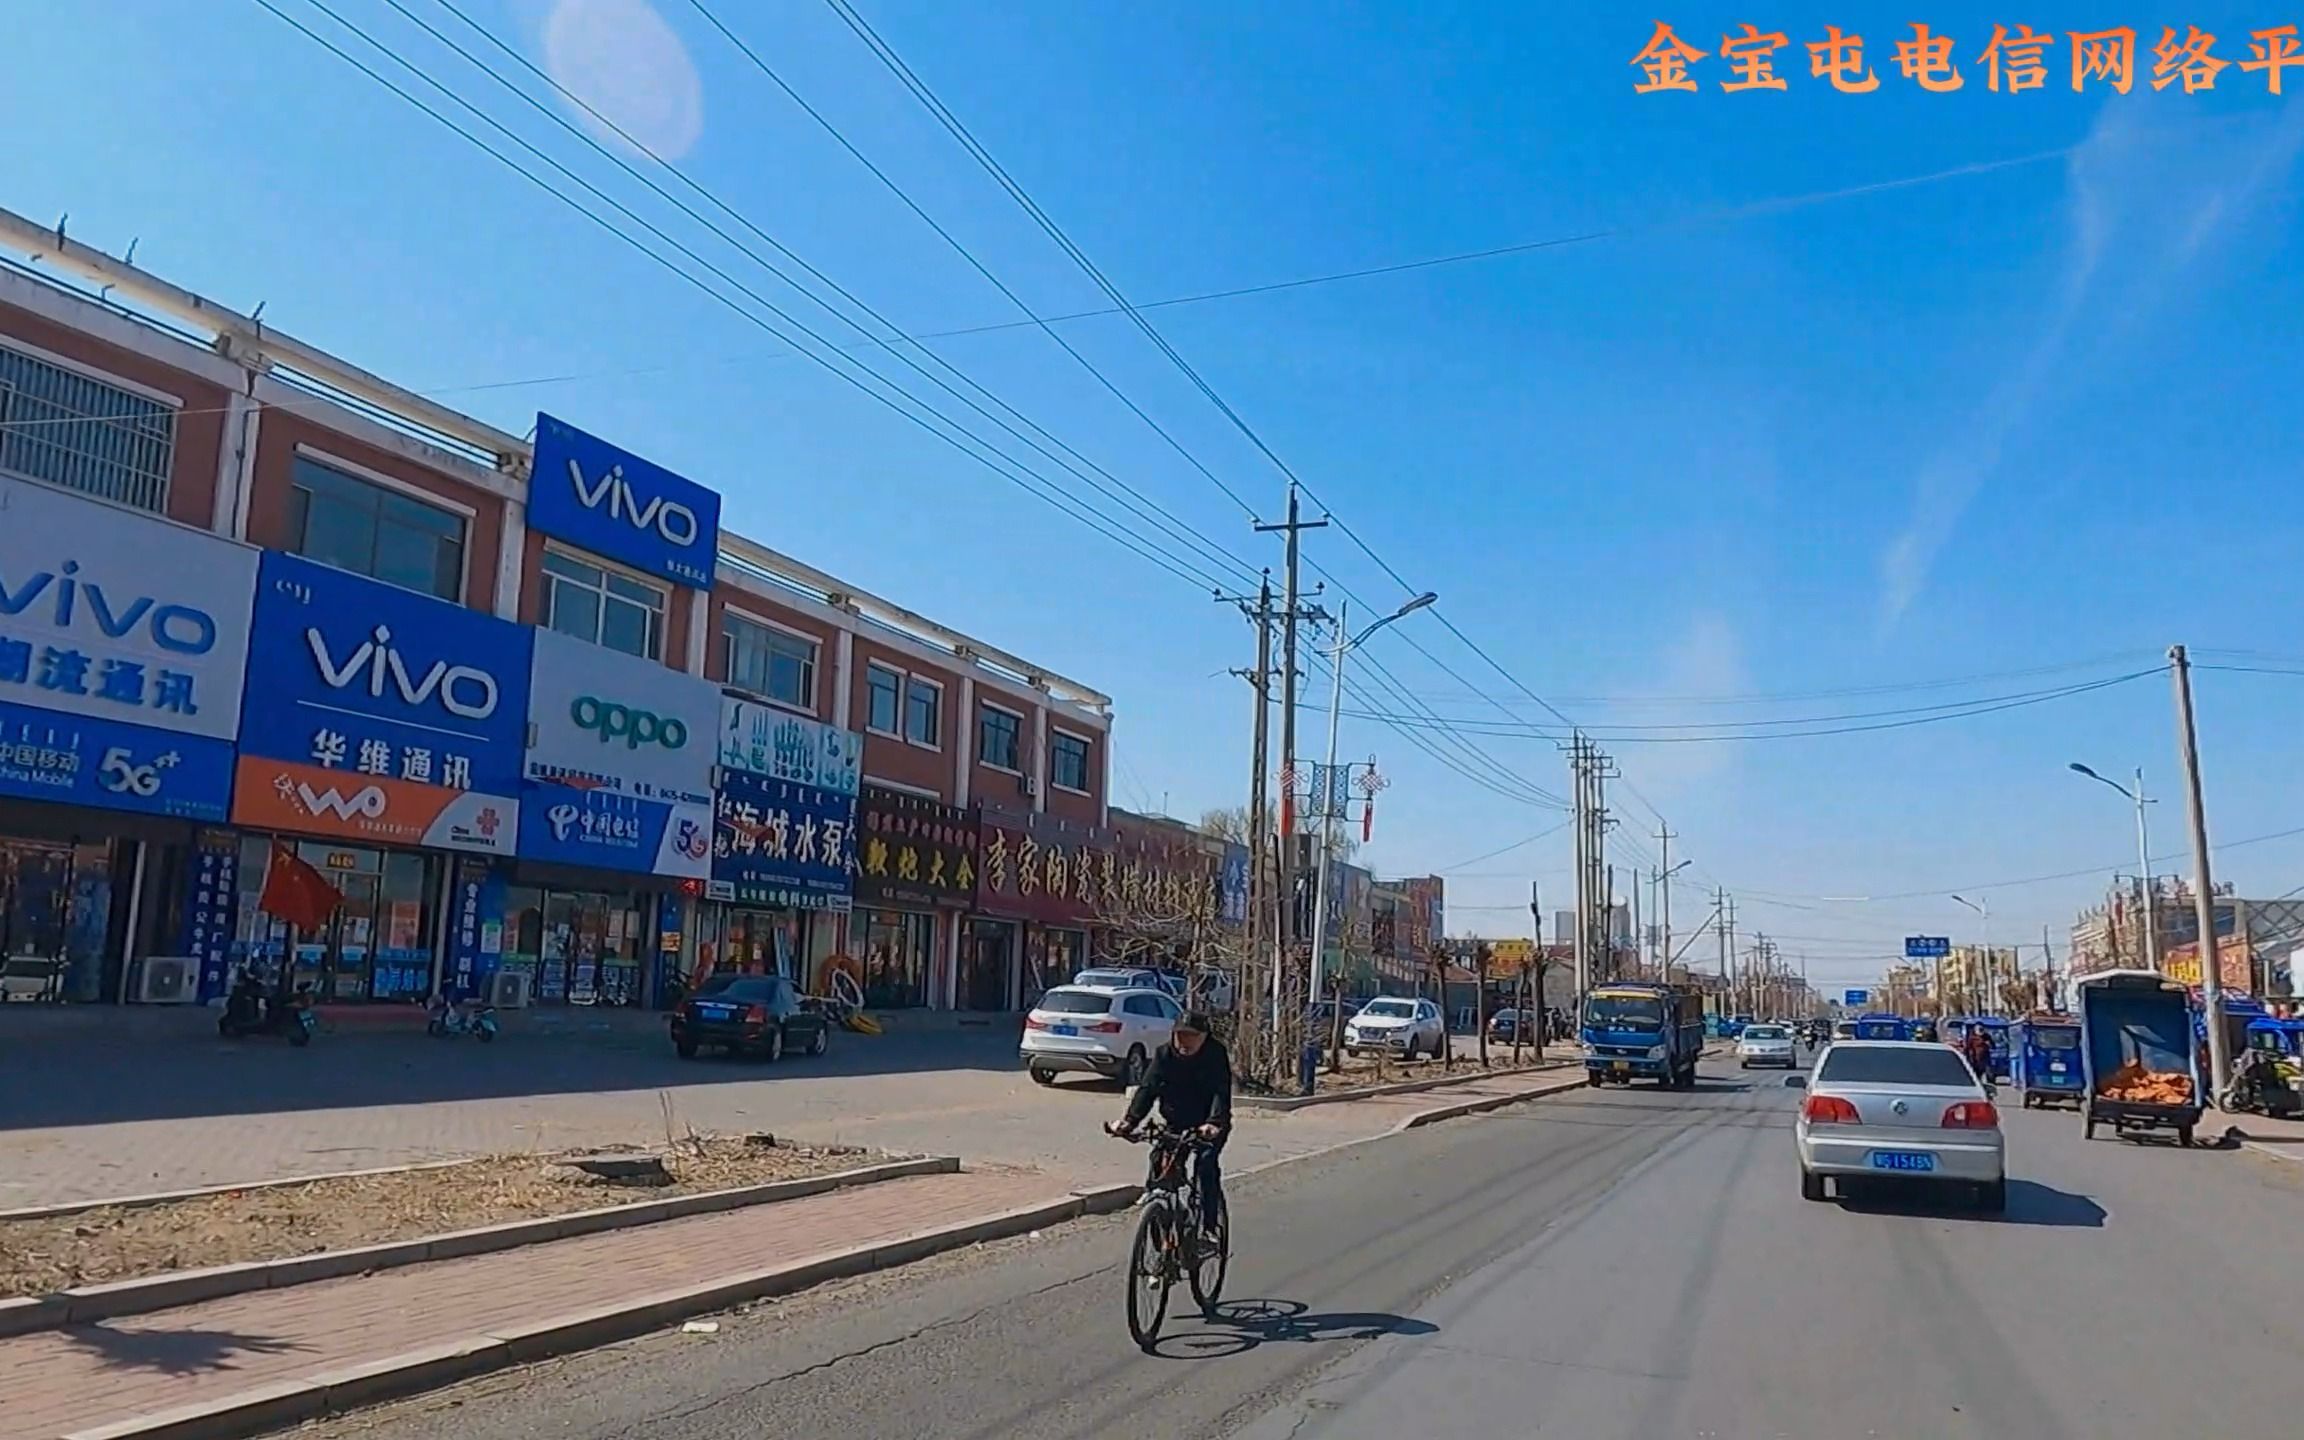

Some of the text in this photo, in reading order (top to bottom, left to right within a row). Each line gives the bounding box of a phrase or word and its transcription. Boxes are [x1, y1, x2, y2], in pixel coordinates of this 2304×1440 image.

[569, 459, 698, 546] vivo
[307, 624, 498, 720] vivo
[0, 741, 79, 773] 中国移动
[311, 728, 472, 790] 华维通讯
